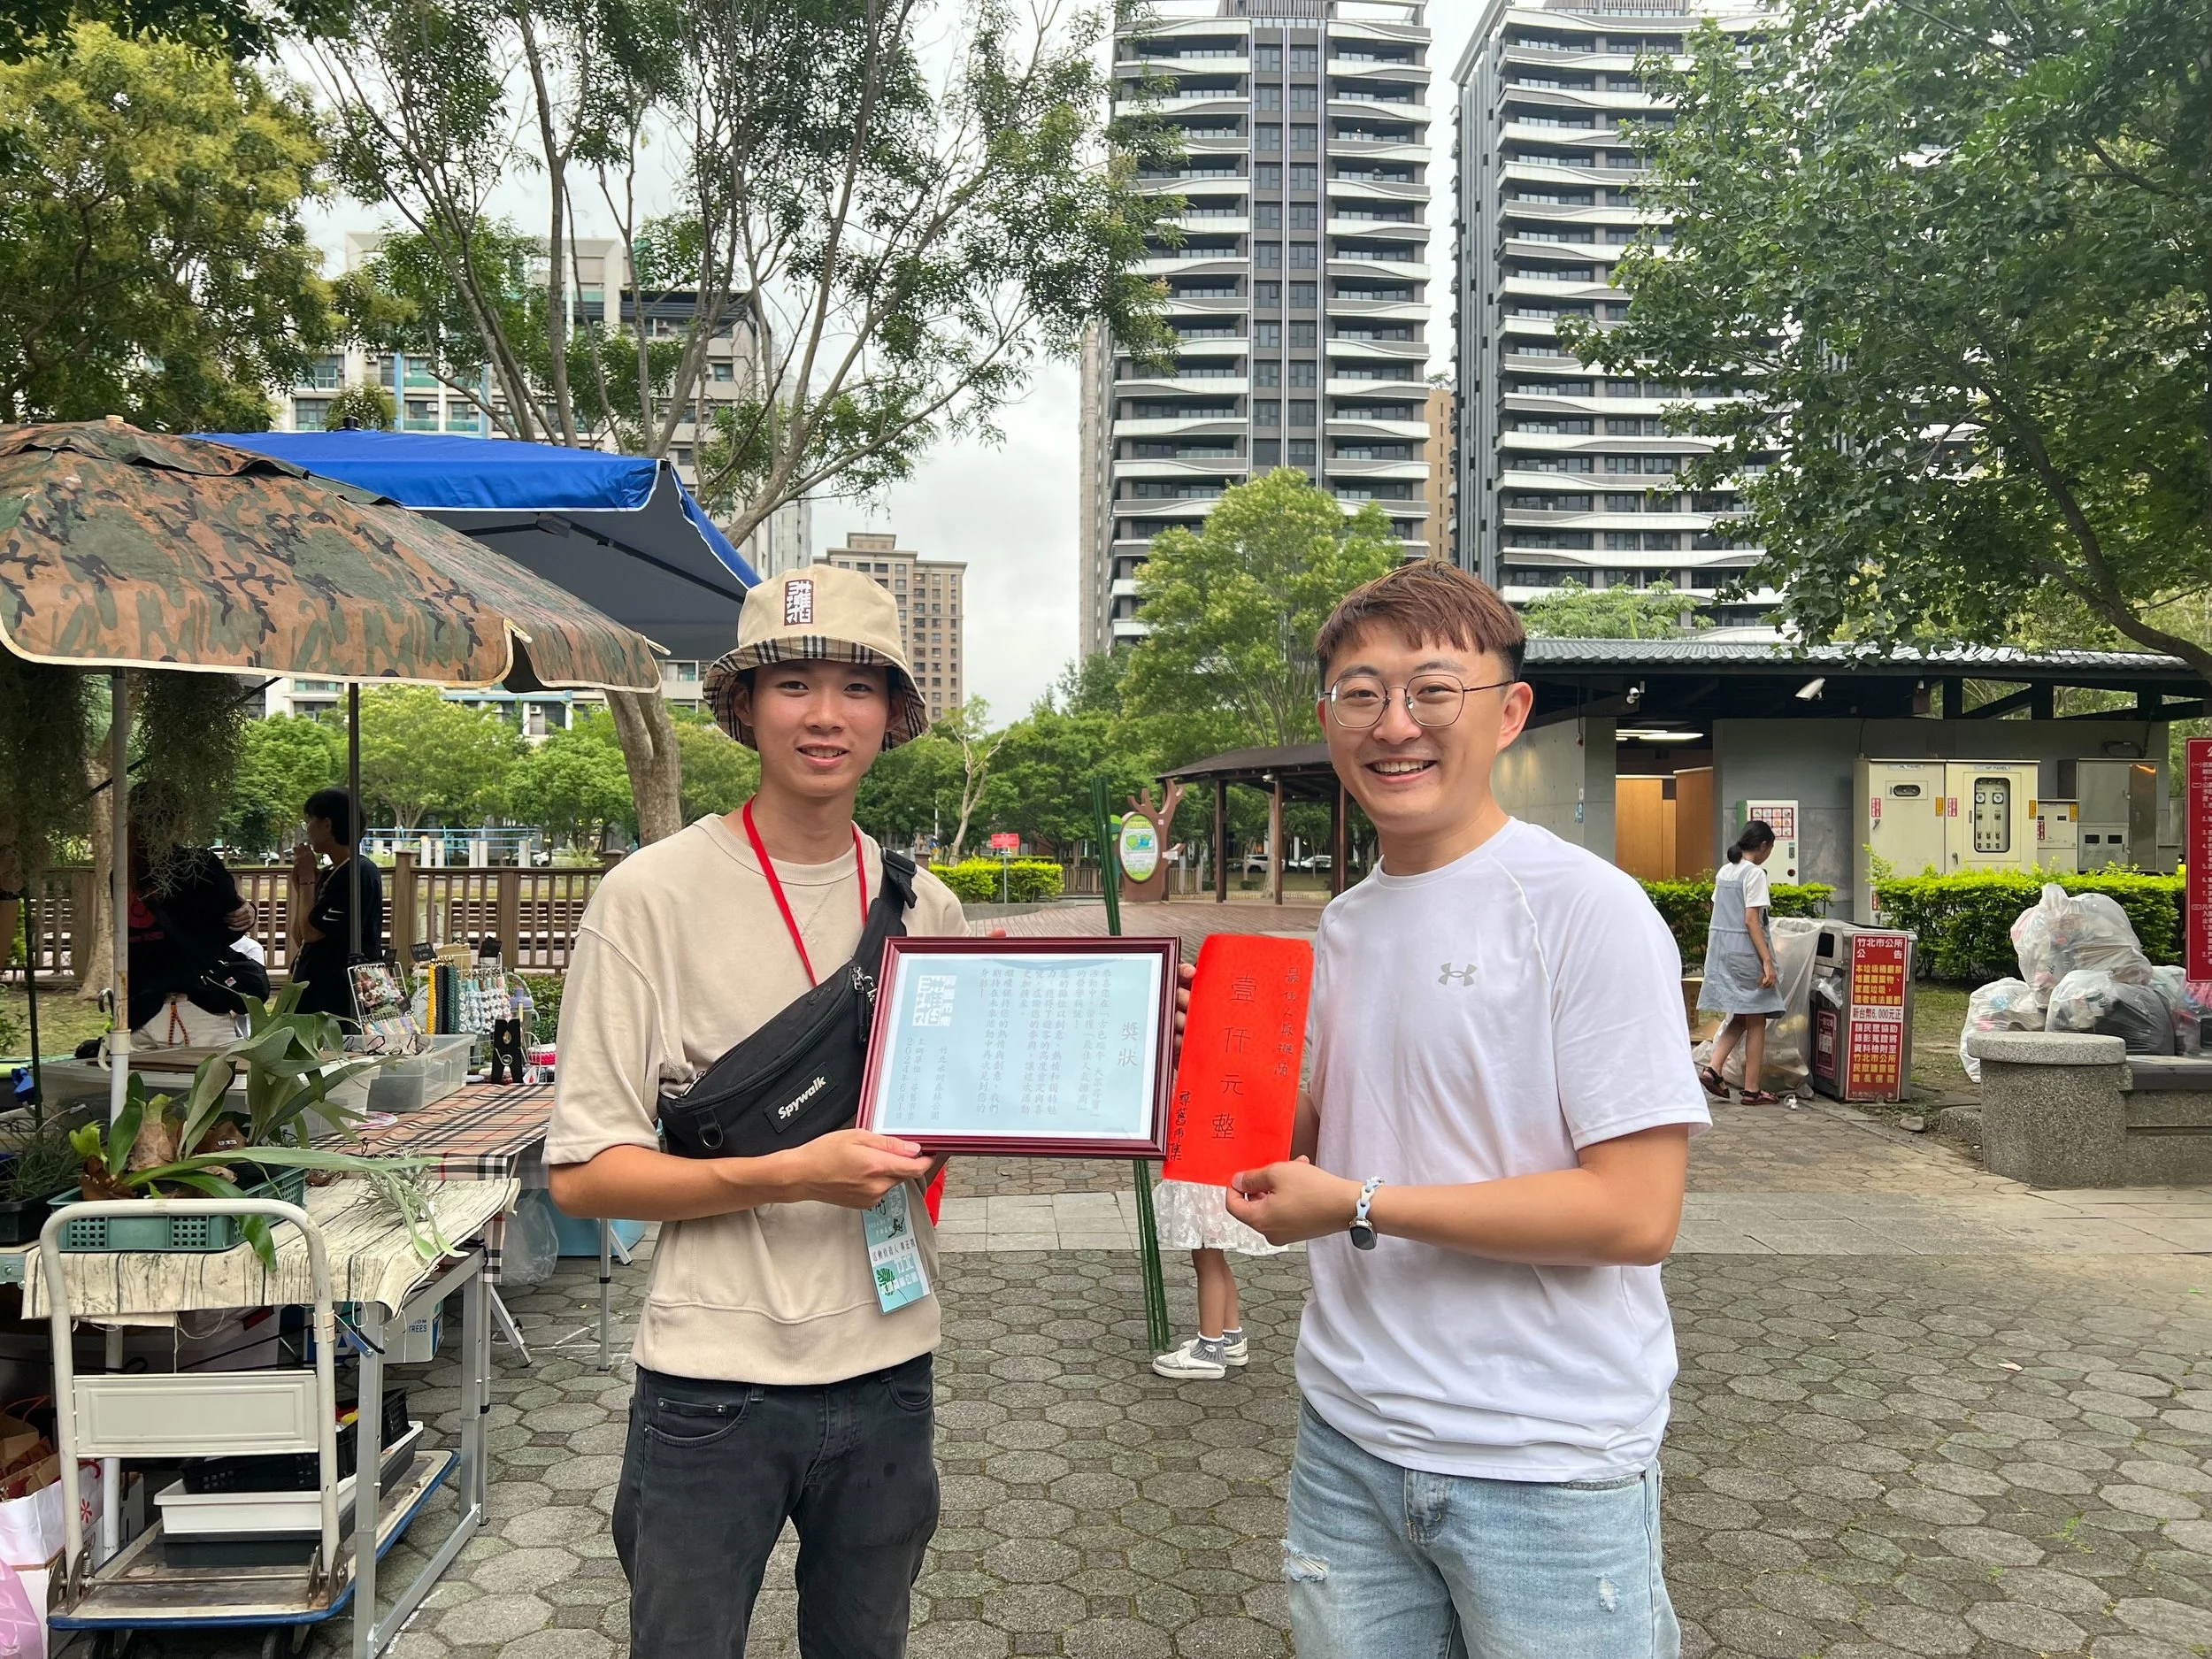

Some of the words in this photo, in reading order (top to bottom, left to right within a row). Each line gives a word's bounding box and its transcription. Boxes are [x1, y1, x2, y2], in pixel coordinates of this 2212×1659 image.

[1857, 938, 1903, 949] 竹北市公所
[1117, 1022, 1139, 1067] 獎狀
[1211, 972, 1258, 1140] 壹仟元整
[1853, 1053, 1896, 1064] 竹北市公所
[778, 1076, 826, 1120] Spywalk
[409, 1325, 427, 1333] TREES
